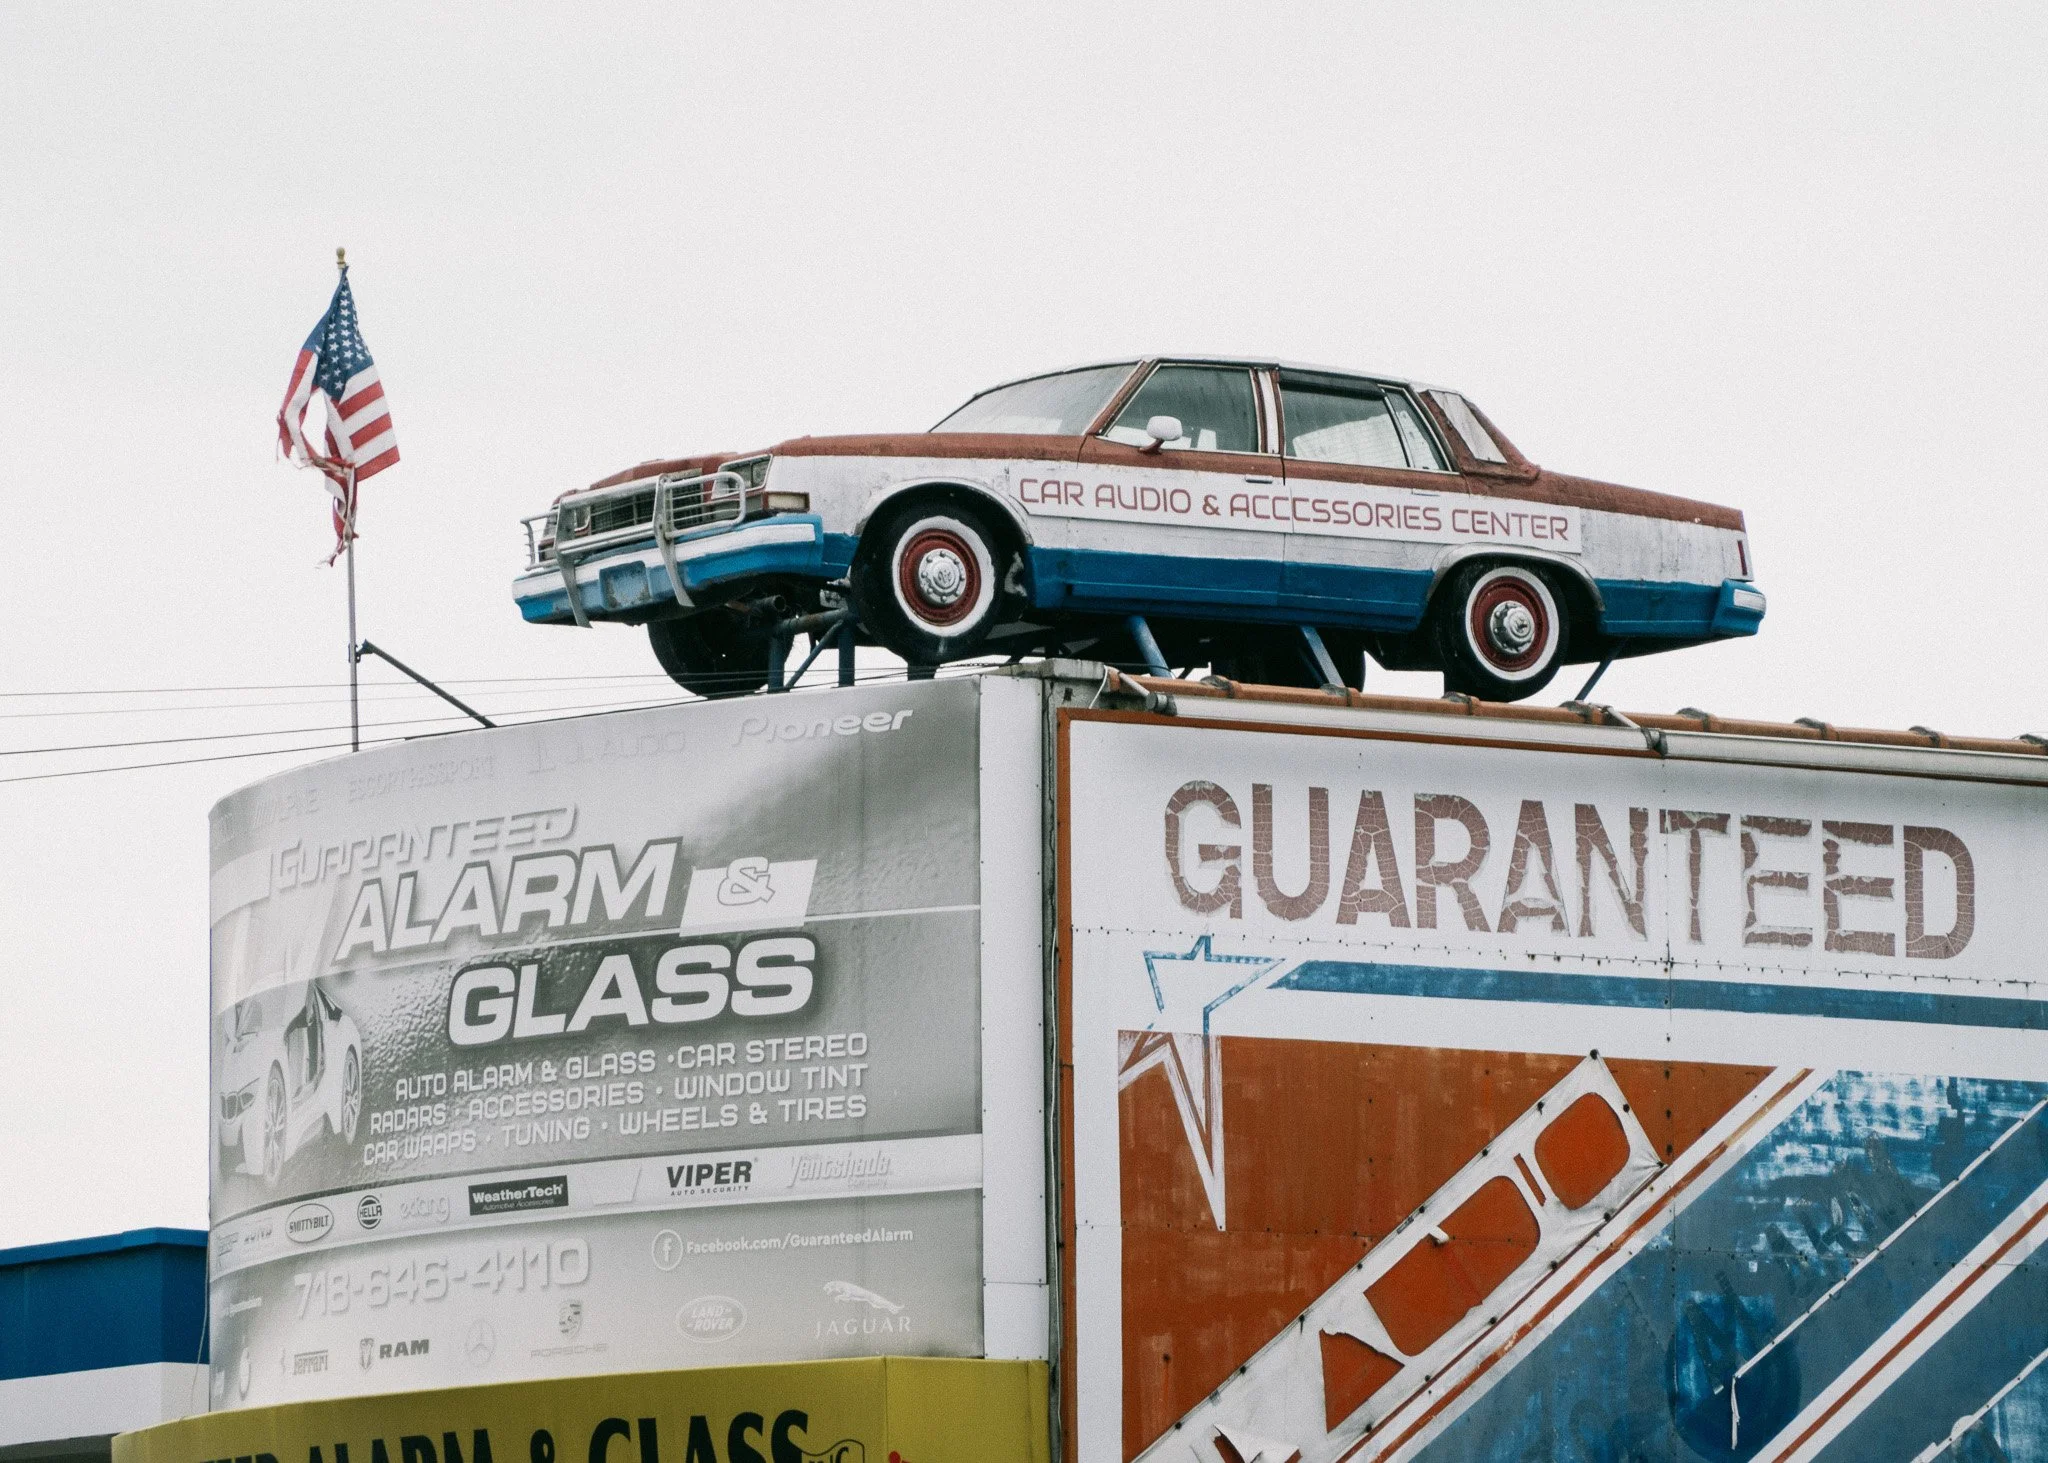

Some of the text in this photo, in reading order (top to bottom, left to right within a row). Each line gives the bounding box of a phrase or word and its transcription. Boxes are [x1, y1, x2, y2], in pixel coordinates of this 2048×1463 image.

[1019, 478, 1084, 505] CAR
[1095, 485, 1192, 513] AUDIO
[1202, 493, 1221, 516] &
[1451, 508, 1569, 541] CENTER
[731, 709, 913, 748] Pioneer
[277, 803, 578, 893] GUARANTEED
[1164, 780, 1976, 960] GUARANTEED
[335, 837, 776, 960] ALARM &
[449, 937, 816, 1046] GLASS
[395, 1032, 868, 1102] AUTO ALARM & GLASS CAR STEREO
[370, 1063, 869, 1135] RADARS ACCESSORIES WINDOW TINT
[363, 1094, 867, 1166] CAR WRAPS TUNING WHEELS & TIRES
[666, 1161, 752, 1188] VIPER
[701, 1185, 749, 1193] SECURITY
[472, 1184, 563, 1204] WeatherTech
[359, 1207, 382, 1219] HELLA
[686, 1228, 914, 1254] Facebook.com/GuaranteedAlarm
[691, 1305, 725, 1319] LAND
[695, 1318, 734, 1332] ROVER
[815, 1316, 912, 1338] JAGUAR
[379, 1338, 430, 1359] RAM
